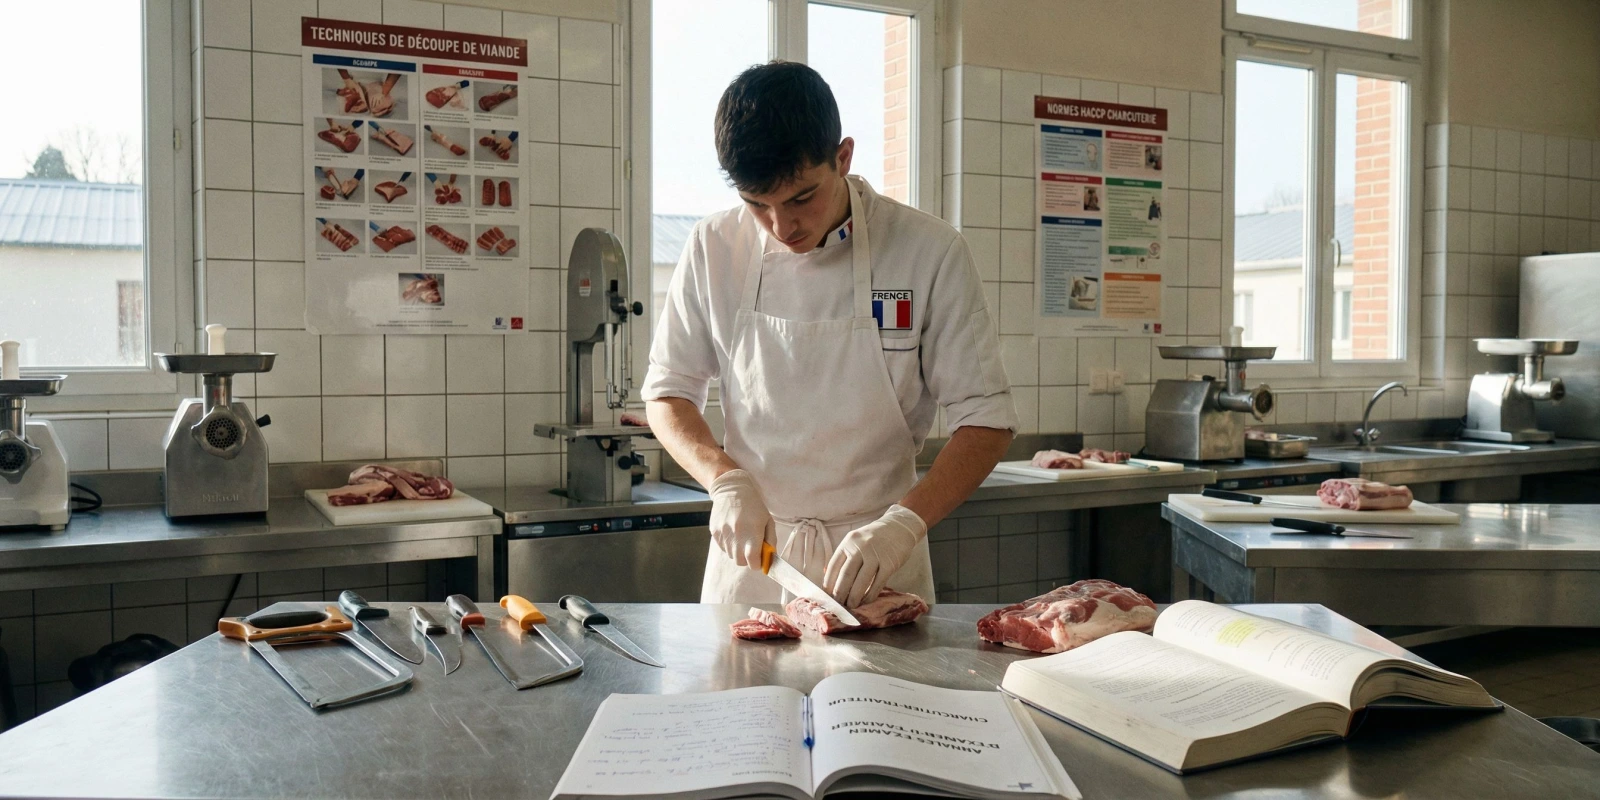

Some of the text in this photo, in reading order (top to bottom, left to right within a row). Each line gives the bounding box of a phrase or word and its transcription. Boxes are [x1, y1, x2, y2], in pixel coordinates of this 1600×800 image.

[310, 26, 520, 59] TECHNIQUES DE DÉCOUPE DE VIANDE
[1047, 103, 1157, 124] NORMES HACCP CHARCUTERIE
[872, 292, 909, 300] FRENCE
